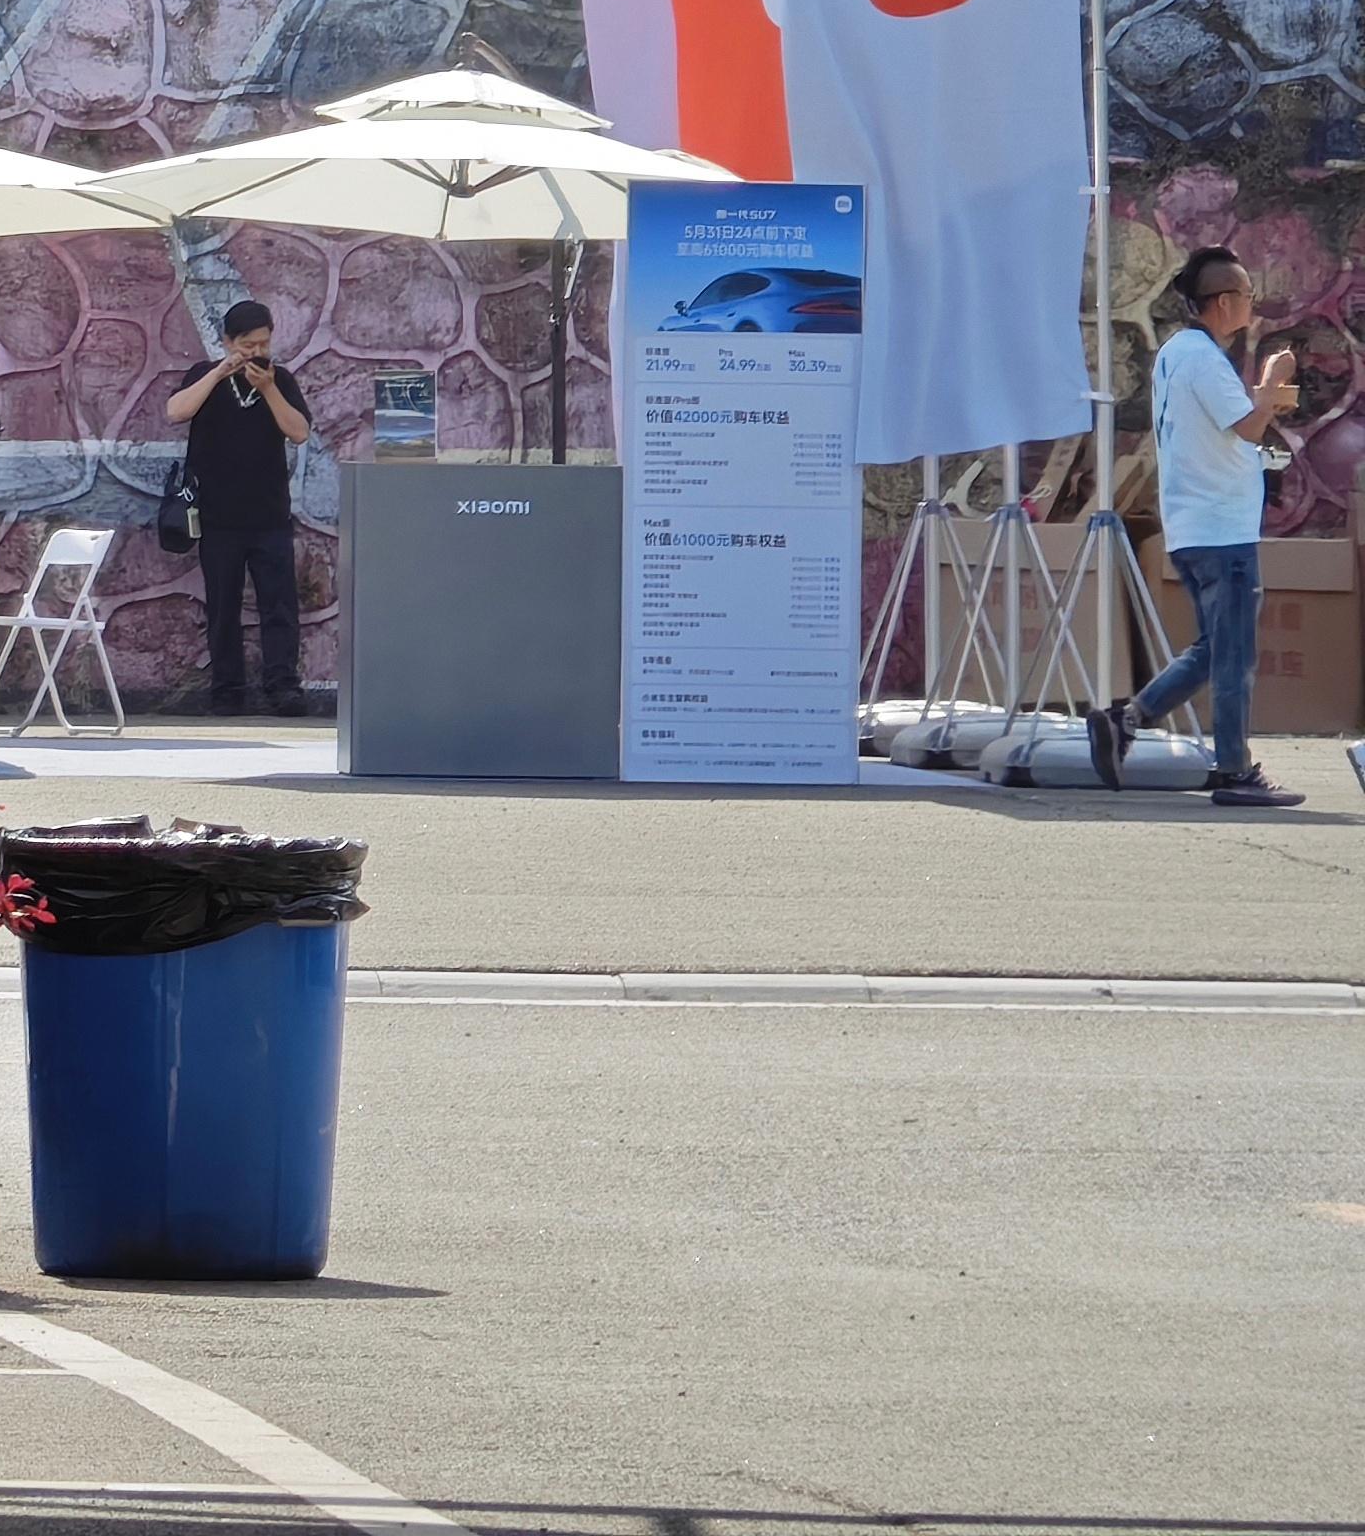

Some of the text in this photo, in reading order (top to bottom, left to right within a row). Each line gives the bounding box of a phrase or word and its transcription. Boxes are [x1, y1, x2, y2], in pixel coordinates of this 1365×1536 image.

[645, 409, 790, 425] 价值42000元购车权益
[644, 532, 787, 548] 价值61000元购车权益
